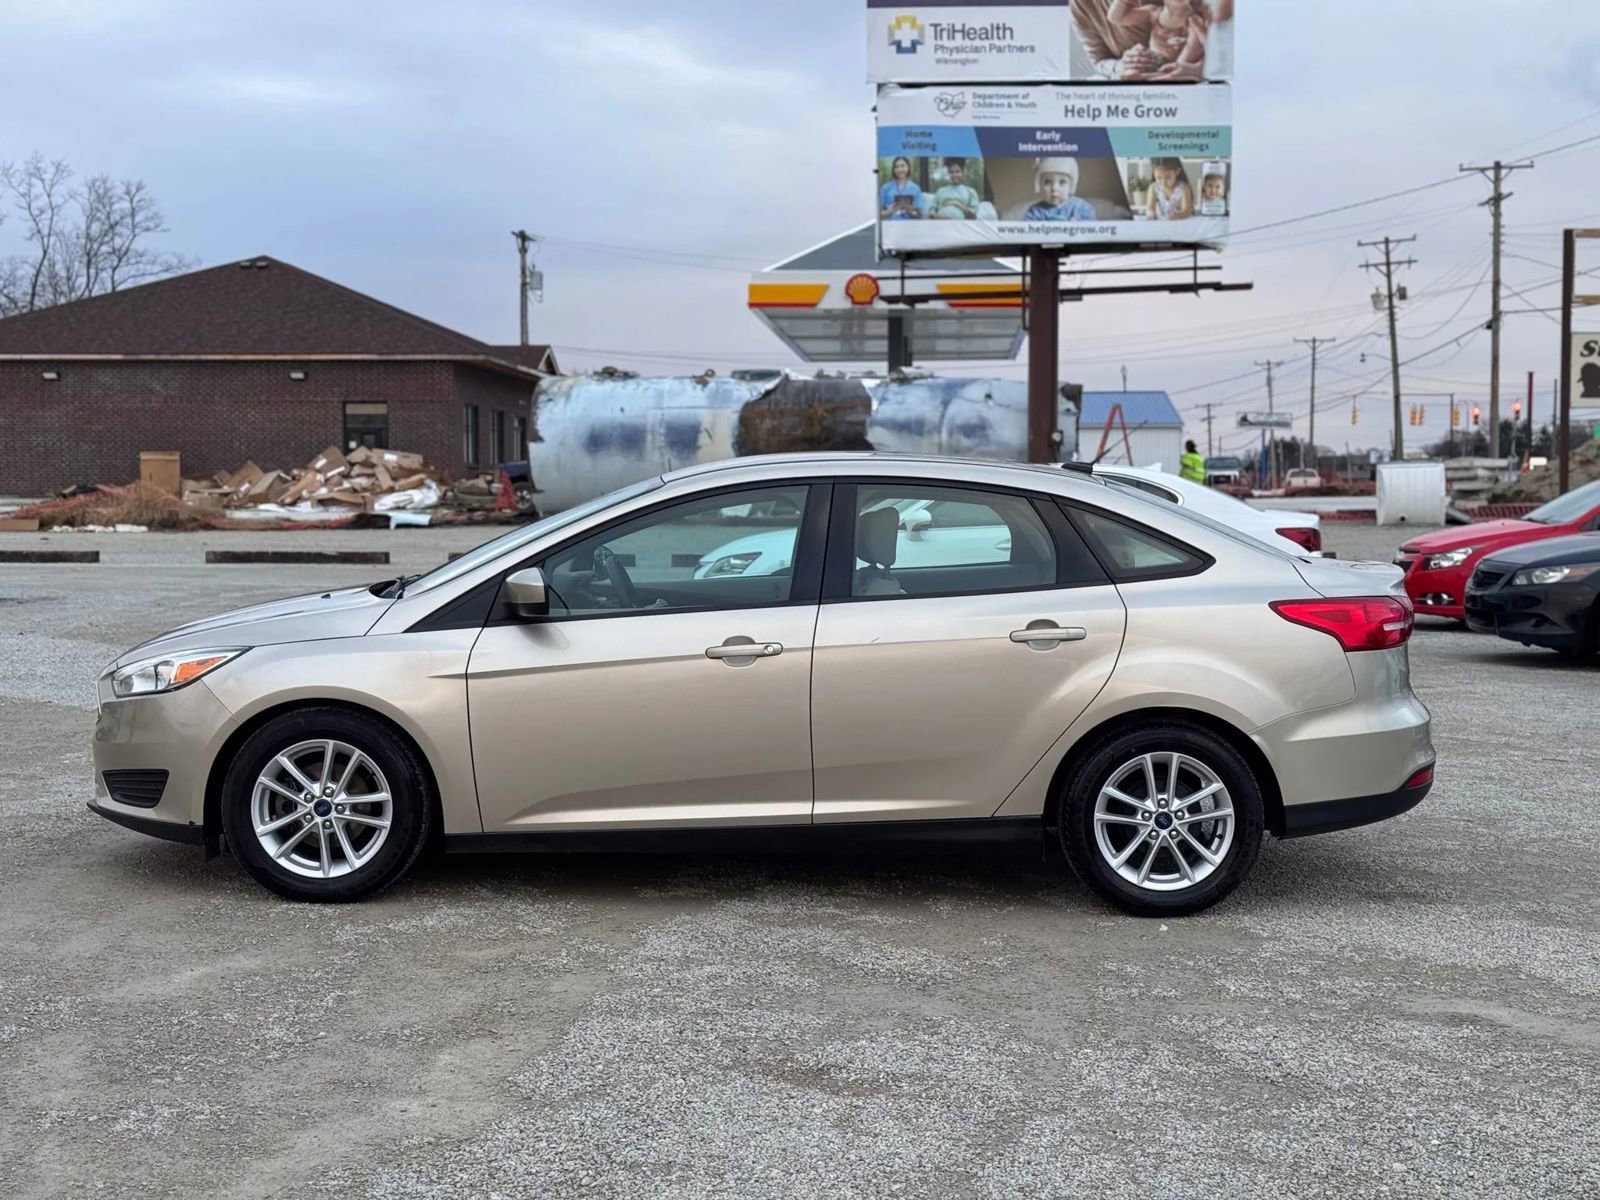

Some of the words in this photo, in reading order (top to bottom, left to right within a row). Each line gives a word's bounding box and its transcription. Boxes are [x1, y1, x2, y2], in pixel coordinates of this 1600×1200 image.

[929, 22, 1014, 41] TriHealth
[934, 43, 987, 56] Physician
[989, 43, 1036, 54] Partners
[972, 92, 1020, 101] Department
[1022, 92, 1030, 100] of
[1056, 91, 1071, 100] The
[1073, 91, 1095, 100] heart
[1097, 91, 1107, 100] of
[1108, 91, 1141, 102] thriving
[972, 101, 1005, 109] Children
[1007, 101, 1014, 109] &
[1015, 101, 1037, 109] Youth
[1064, 103, 1102, 121] Help
[1106, 104, 1130, 118] Me
[1134, 104, 1178, 119] Grow
[906, 130, 932, 138] Home
[1036, 131, 1061, 141] Early
[1147, 130, 1220, 140] Developmental
[901, 141, 937, 152] Visiting
[1018, 142, 1078, 151] Intervention
[1158, 142, 1209, 151] Screenings
[997, 224, 1117, 236] www.helpmegrow.org
